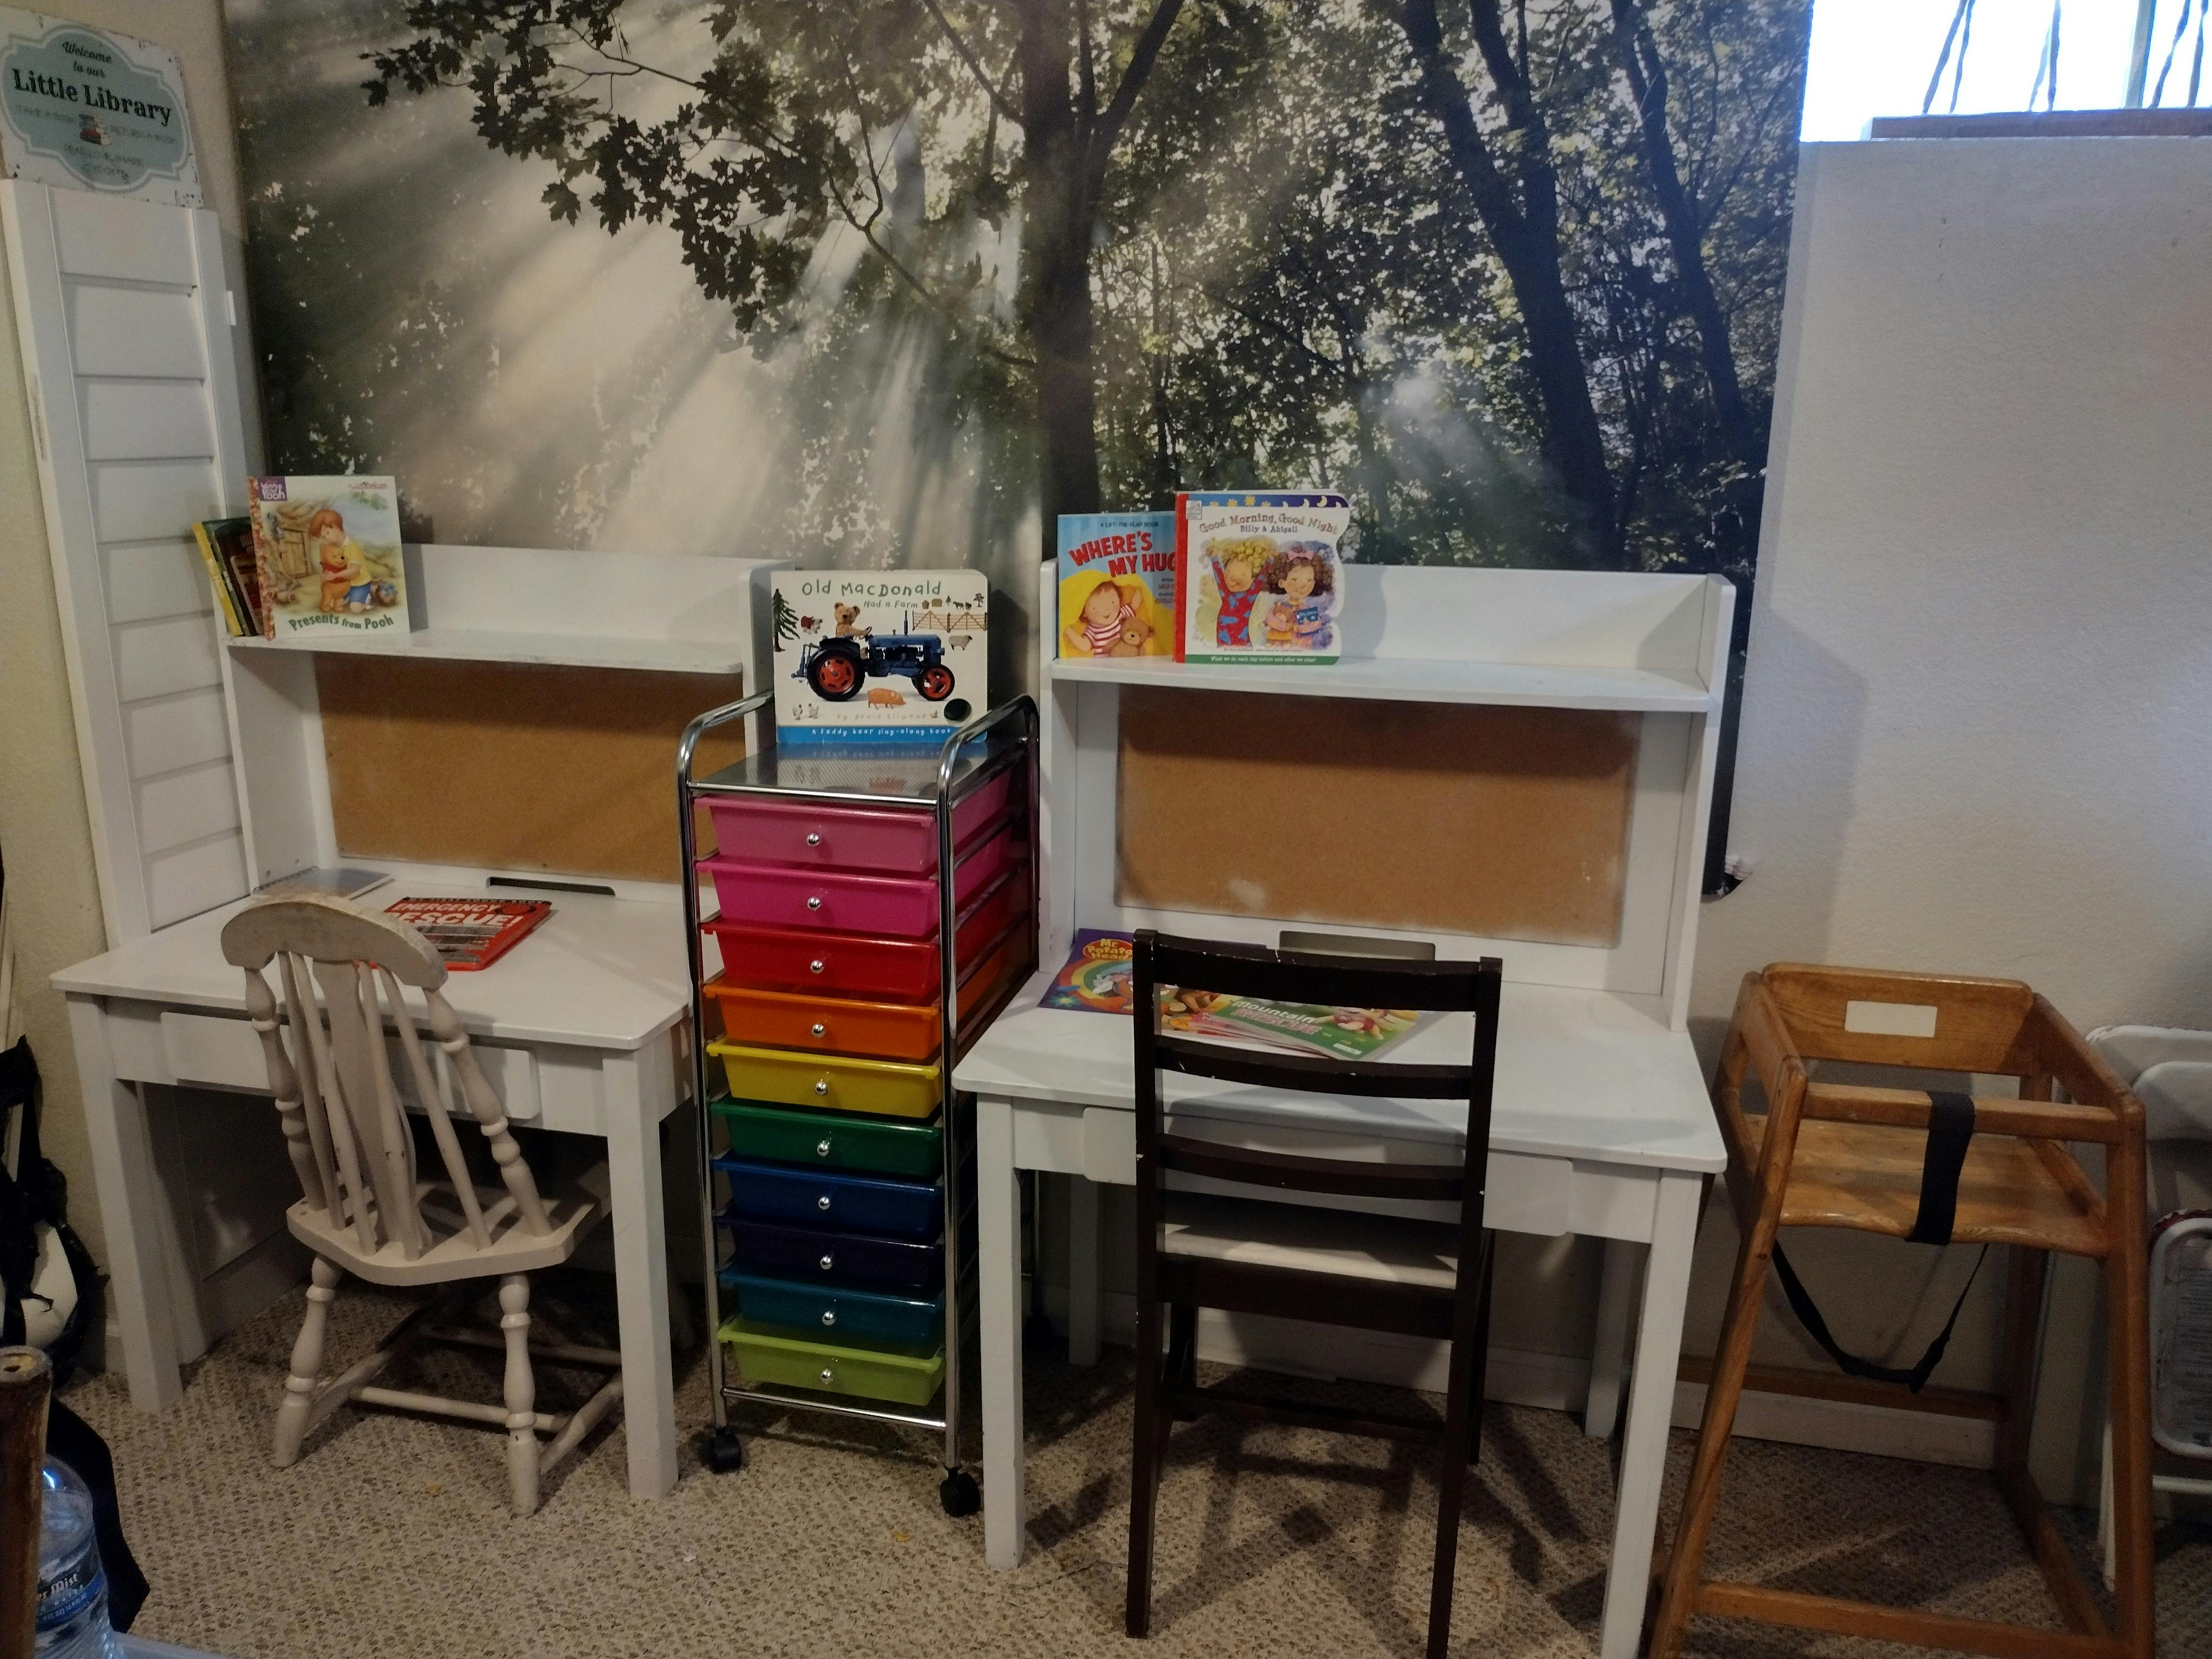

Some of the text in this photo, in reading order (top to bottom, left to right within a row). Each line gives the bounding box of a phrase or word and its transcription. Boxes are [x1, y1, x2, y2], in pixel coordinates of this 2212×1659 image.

[62, 41, 112, 64] Welcome
[74, 60, 84, 72] to
[12, 68, 78, 102] Little
[82, 84, 172, 127] Library
[1199, 518, 1227, 533] Good
[1279, 513, 1305, 525] Good
[1307, 517, 1338, 535] Night
[1240, 525, 1259, 533] Billy
[1068, 530, 1152, 567] WHERE'S
[1108, 555, 1138, 577] MY
[801, 579, 942, 597] Old MacDonald
[288, 613, 394, 632] Presents from Pooh
[821, 728, 847, 737] teddy
[878, 728, 925, 737] sing-along
[390, 902, 502, 913] EMERGENCY
[1087, 946, 1133, 954] Potato
[1091, 951, 1129, 960] Head
